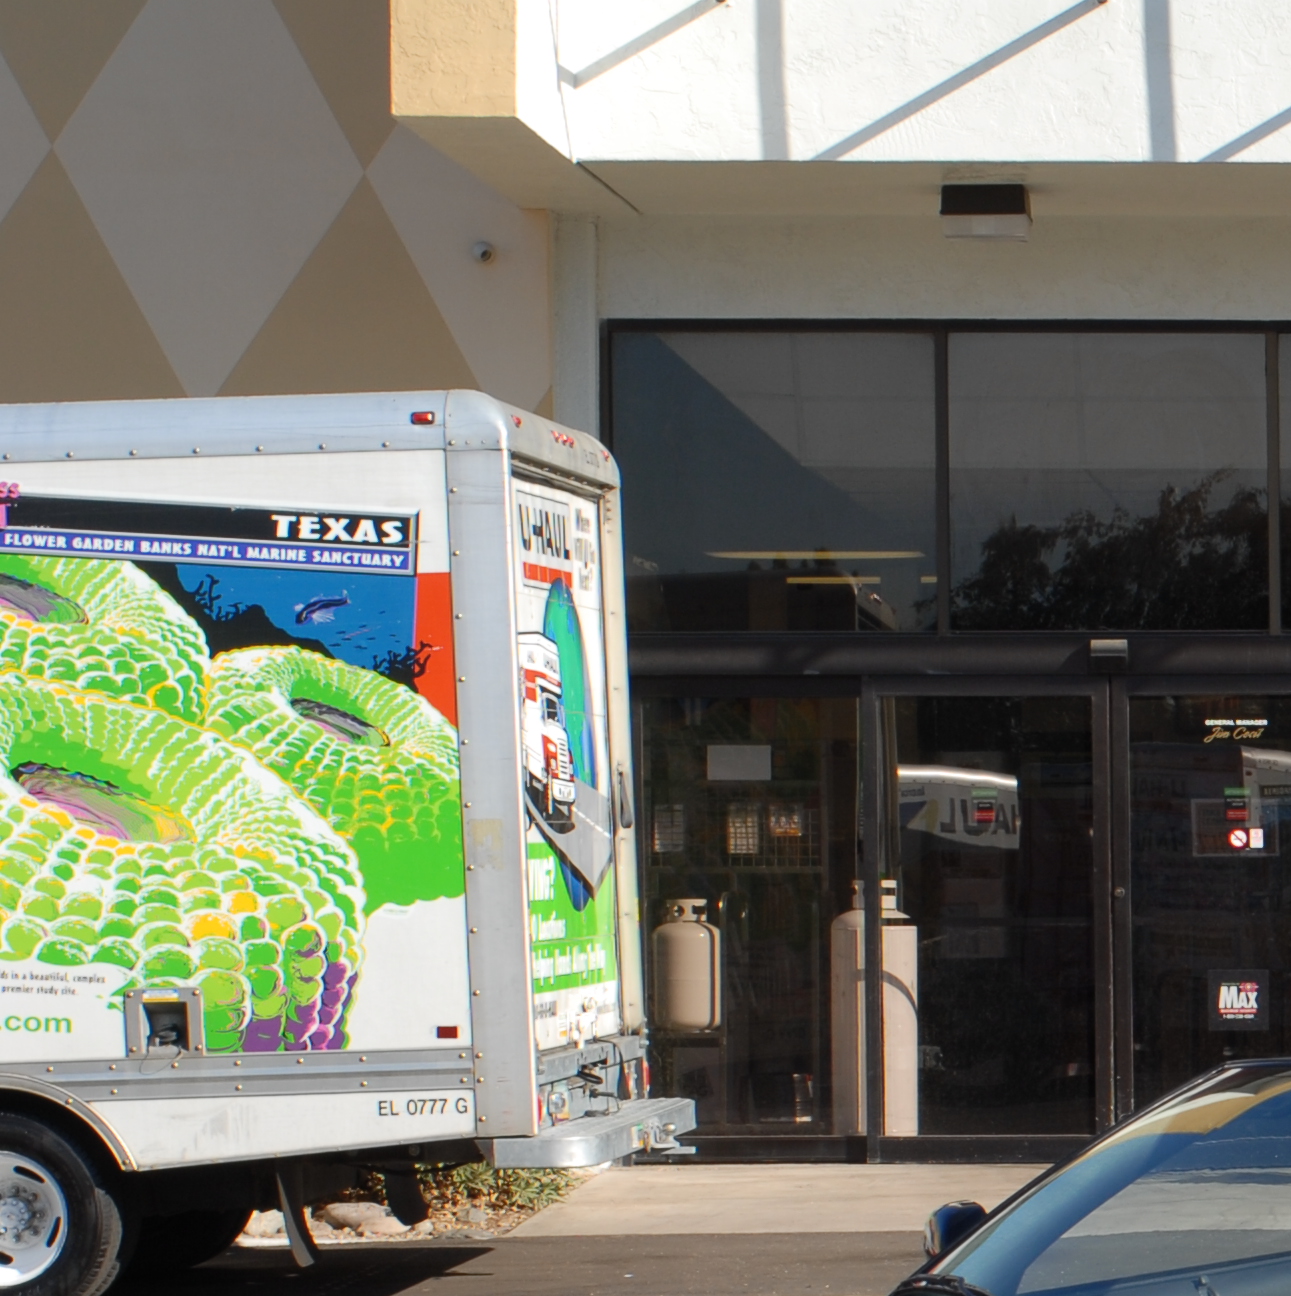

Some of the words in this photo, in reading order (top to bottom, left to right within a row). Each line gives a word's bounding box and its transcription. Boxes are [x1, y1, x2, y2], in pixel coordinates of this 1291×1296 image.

[271, 514, 404, 545] TEXAS
[3, 532, 68, 549] FLOWER
[72, 536, 135, 552] GARDEN
[139, 540, 192, 556] BANKS
[197, 544, 242, 558] NAT'L
[246, 546, 308, 562] MARINE
[312, 550, 405, 568] SANCTUARY
[1, 985, 34, 994] premier
[36, 987, 59, 996] study
[1219, 985, 1258, 1009] MAX
[378, 1101, 399, 1116] EL
[406, 1099, 448, 1115] 0777
[455, 1098, 468, 1114] G
